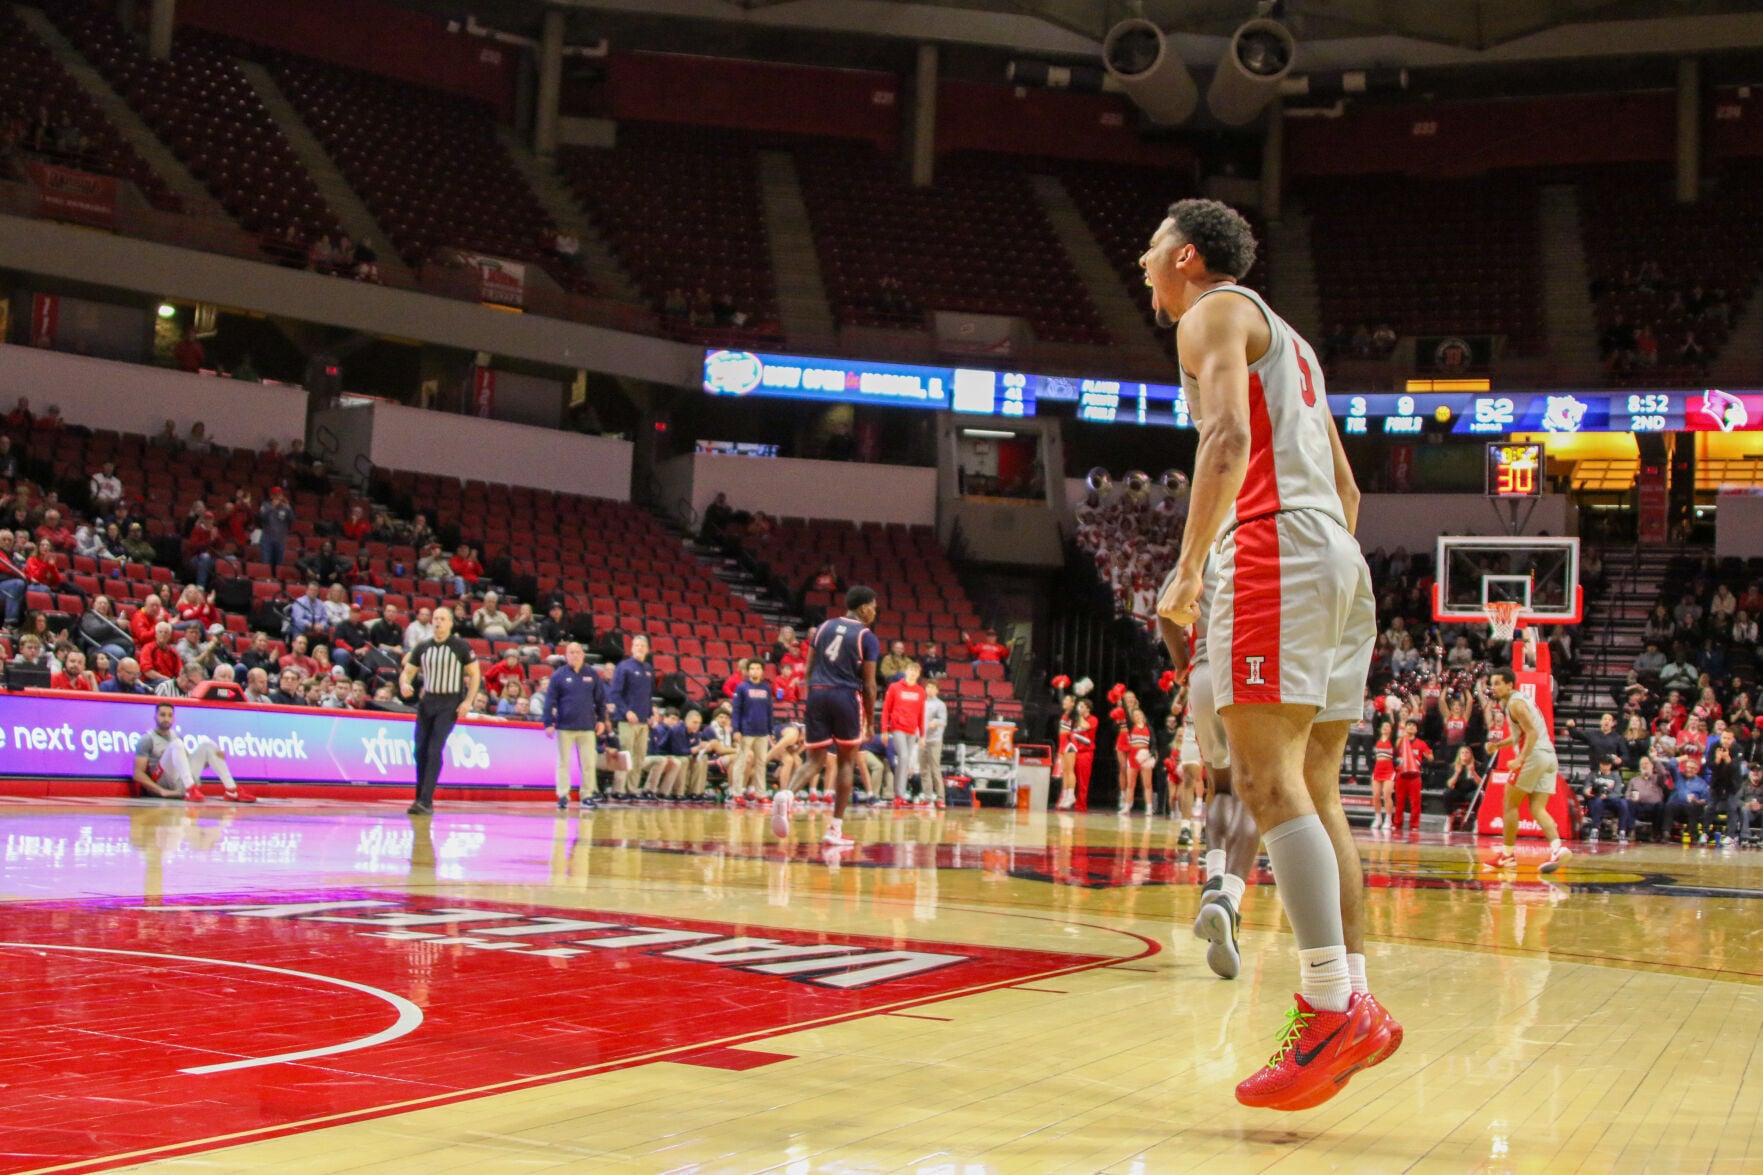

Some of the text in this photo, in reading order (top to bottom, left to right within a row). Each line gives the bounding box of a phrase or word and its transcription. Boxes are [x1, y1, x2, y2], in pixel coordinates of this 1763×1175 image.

[1292, 337, 1316, 408] 5
[1351, 396, 1366, 415] 3
[1398, 396, 1414, 415] 9
[1475, 398, 1514, 423] 52
[1627, 394, 1669, 413] 8:52
[1630, 415, 1666, 430] 2ND
[1498, 464, 1532, 491] 30
[824, 634, 844, 662] 4
[13, 723, 75, 752] next
[219, 731, 307, 760] network
